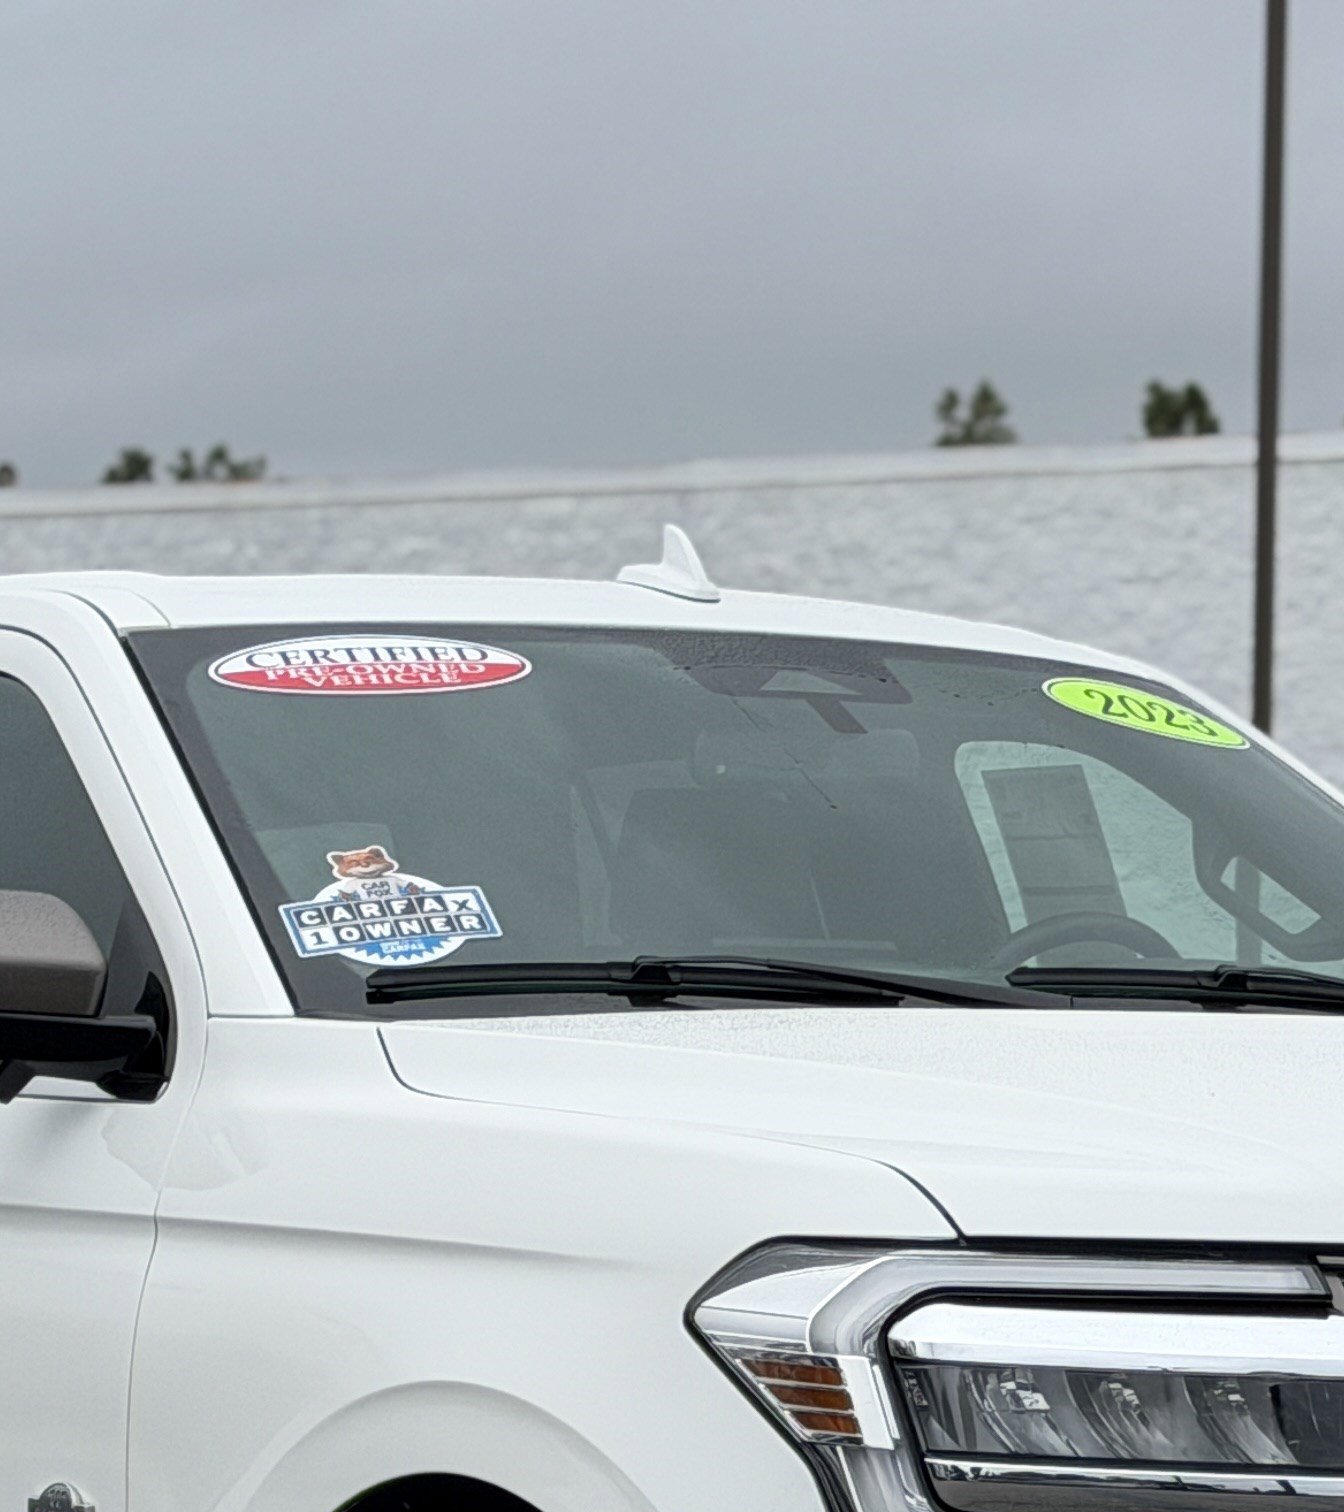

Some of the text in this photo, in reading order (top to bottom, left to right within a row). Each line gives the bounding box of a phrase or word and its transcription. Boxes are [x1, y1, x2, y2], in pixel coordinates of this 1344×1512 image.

[245, 646, 489, 669] CERTIFIED
[265, 662, 487, 681] PRE-OWNED
[304, 672, 462, 687] VEHICLE
[1082, 688, 1219, 737] 2023
[361, 880, 390, 890] CAR
[365, 888, 393, 897] FOX
[299, 895, 476, 926] CARFAX
